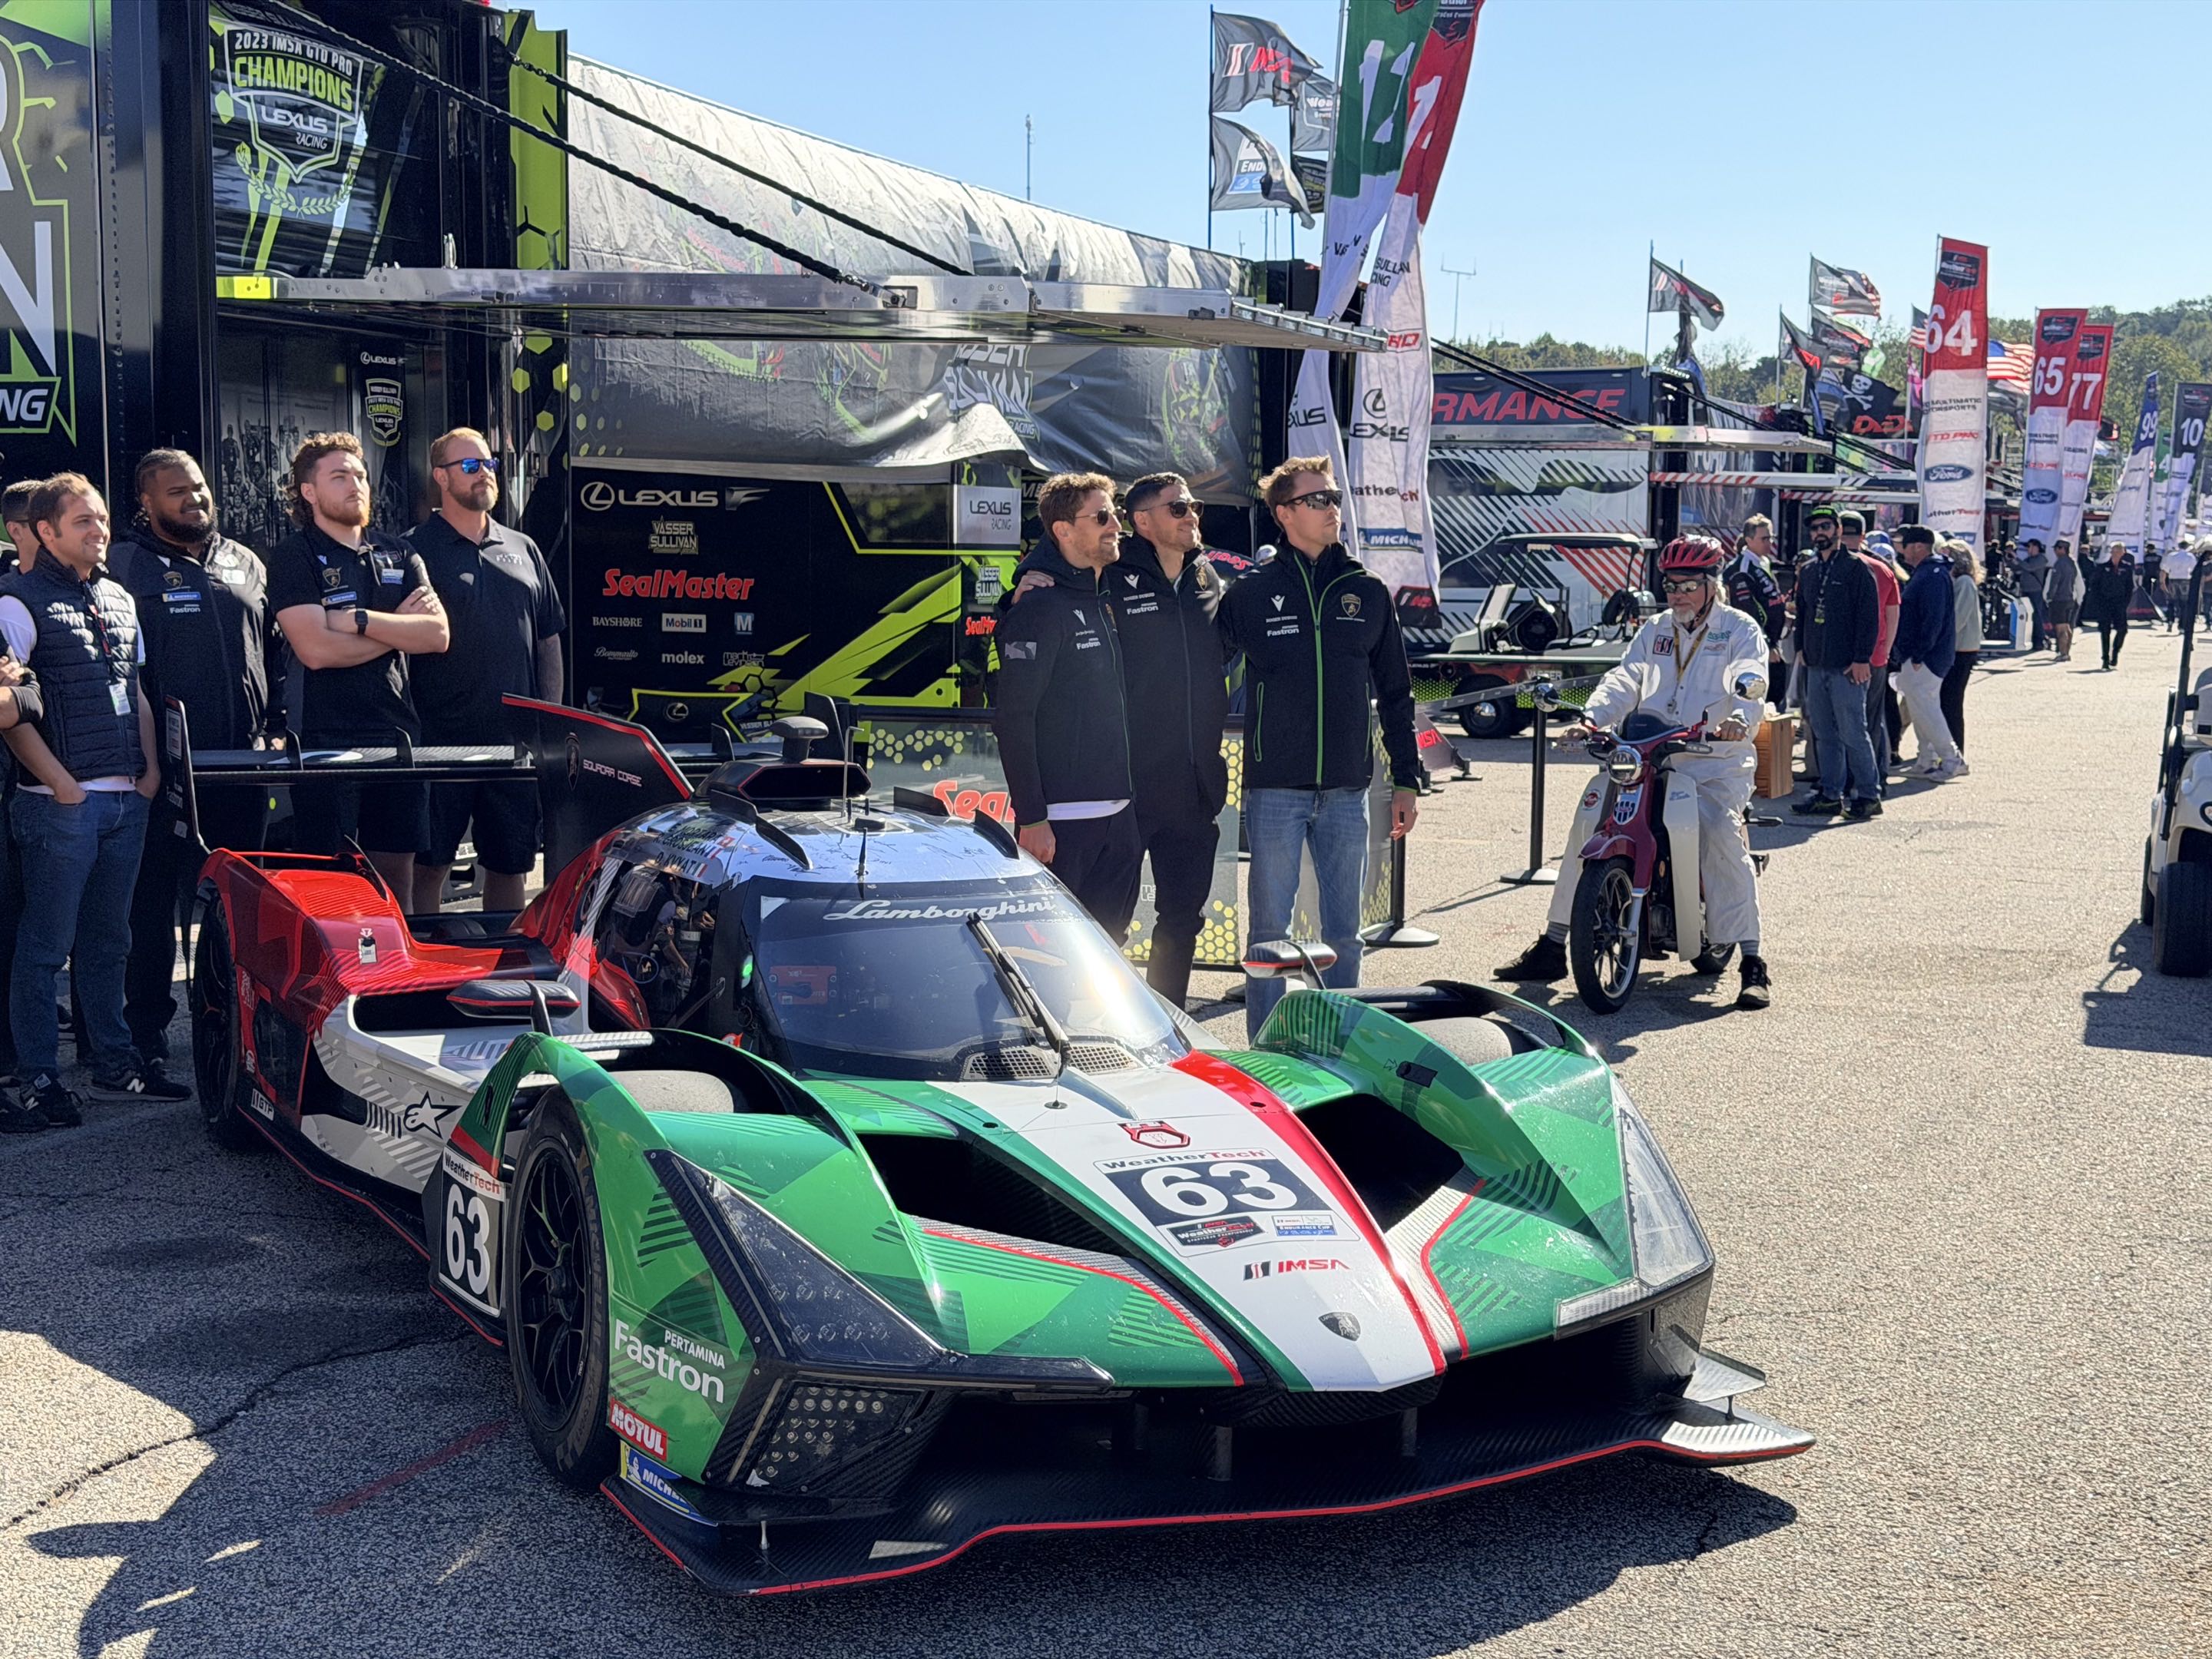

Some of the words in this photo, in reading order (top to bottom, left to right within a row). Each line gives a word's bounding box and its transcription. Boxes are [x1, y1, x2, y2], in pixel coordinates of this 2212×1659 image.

[235, 32, 268, 50] 2023
[272, 35, 302, 55] IMSA
[306, 41, 328, 64] GTD
[331, 51, 353, 77] PRO
[234, 56, 353, 112] CHAMPIONS
[260, 105, 328, 134] LEXUS
[296, 132, 328, 149] RACING
[1926, 304, 1978, 356] 64
[370, 356, 396, 365] LEXUS
[2035, 357, 2066, 396] 65
[2070, 373, 2101, 410] 77
[2181, 418, 2204, 446] 10
[1929, 467, 1963, 480] Ford
[618, 489, 718, 507] LEXUS
[970, 501, 1012, 515] LEXUS
[654, 522, 694, 535] VASSER
[992, 518, 1012, 530] RACING
[651, 536, 697, 549] SULLIVAN
[603, 568, 754, 601] SealMaster
[1127, 605, 1158, 614] Fastron
[593, 617, 642, 628] BAYSHORE
[666, 618, 691, 628] Mobil
[694, 618, 703, 628] 1
[736, 615, 753, 631] M
[1267, 628, 1299, 637] Fastron
[1076, 641, 1101, 650] Fastron
[661, 651, 704, 664] molex
[584, 759, 615, 777] SQUADRA
[618, 770, 642, 787] CORSE
[664, 853, 696, 874] KVYAT
[823, 896, 1055, 921] Lamborghini
[1104, 1150, 1267, 1169] WeatherTech
[445, 1153, 500, 1194] WeatherTech
[1141, 1163, 1298, 1217] 63
[446, 1184, 491, 1295] 63
[1177, 1222, 1255, 1239] WeatherTech
[1278, 1259, 1351, 1273] IMSA
[664, 1330, 725, 1369] PERTAMINA
[614, 1319, 724, 1403] Fastron
[611, 1404, 664, 1455] MOTUL
